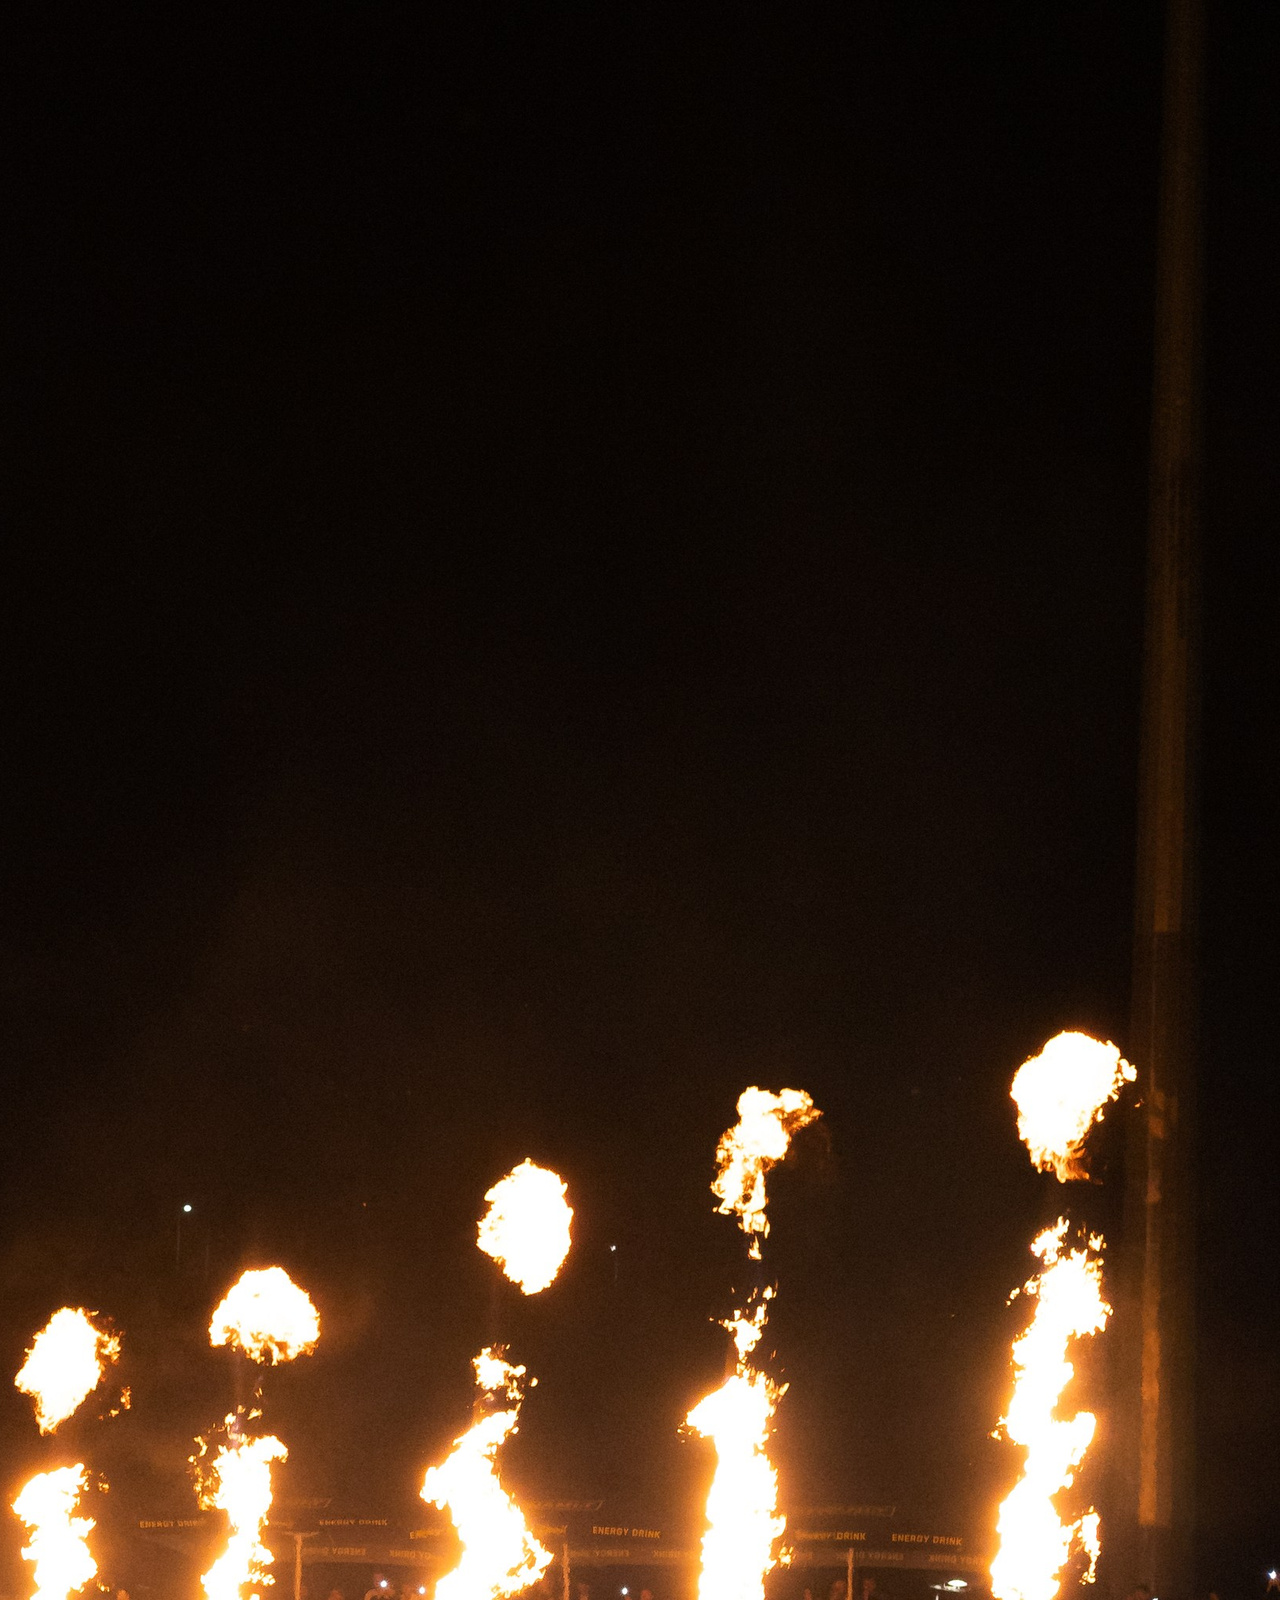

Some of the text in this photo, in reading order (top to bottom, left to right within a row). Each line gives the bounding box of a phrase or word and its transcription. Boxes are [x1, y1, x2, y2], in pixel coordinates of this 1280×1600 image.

[139, 1519, 175, 1529] ENERGY
[592, 1525, 661, 1540] ENERGY DRINK
[836, 1531, 867, 1541] DRINK
[891, 1533, 963, 1546] ENERGY DRINK
